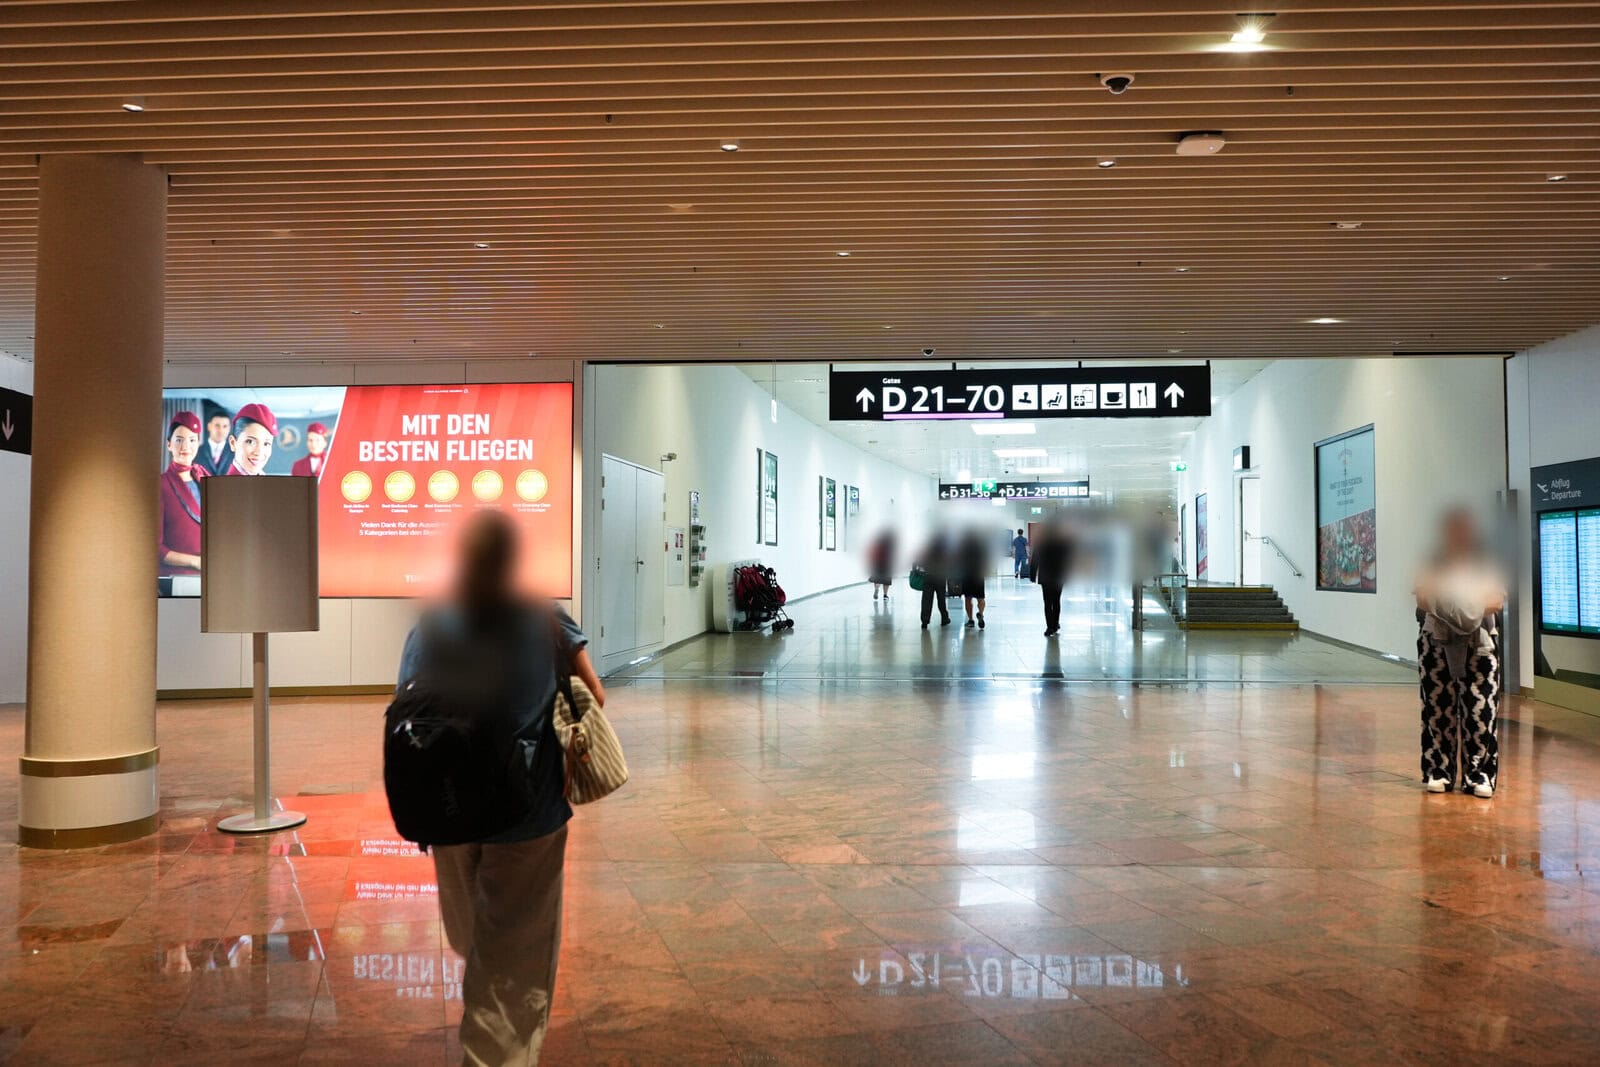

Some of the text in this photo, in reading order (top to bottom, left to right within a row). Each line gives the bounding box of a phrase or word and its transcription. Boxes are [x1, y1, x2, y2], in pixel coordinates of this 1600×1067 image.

[402, 413, 490, 436] MIT DEN
[359, 439, 533, 462] BESTEN FLIEGEN
[1550, 478, 1570, 489] Abflug
[1551, 490, 1582, 501] Departure
[364, 529, 398, 537] Kategorien
